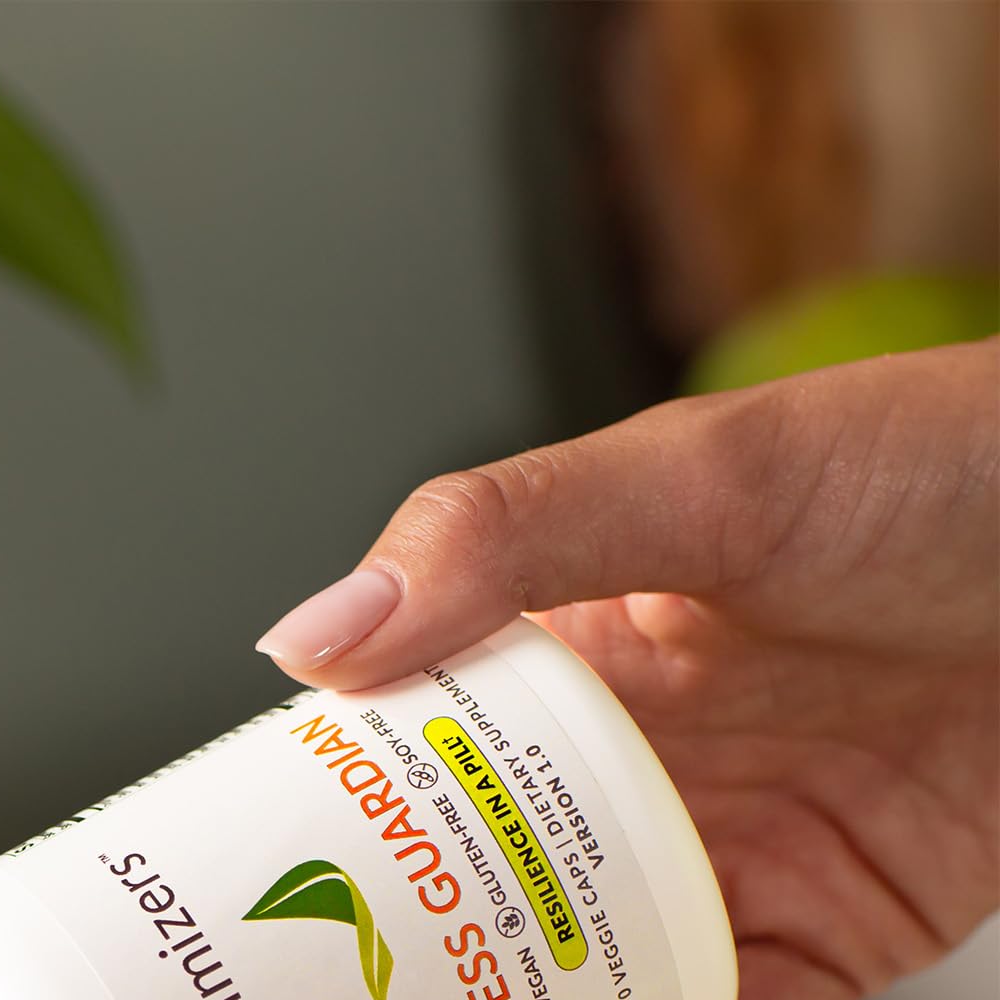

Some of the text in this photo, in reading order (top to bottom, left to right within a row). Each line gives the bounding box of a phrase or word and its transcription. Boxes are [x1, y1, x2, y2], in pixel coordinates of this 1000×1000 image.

[360, 708, 418, 765] SOY-FREE
[424, 665, 510, 752] SUPPLEMENT
[290, 713, 461, 914] GUARDIAN
[476, 774, 496, 791] A
[486, 793, 512, 820] IN
[504, 756, 563, 837] DIETARY
[525, 744, 605, 870] VERSION 1.0
[432, 793, 507, 906] GLUTEN-FREE
[503, 819, 575, 943] RESILIENCE
[564, 852, 598, 906] CAPS
[590, 909, 627, 986] VEGGIE
